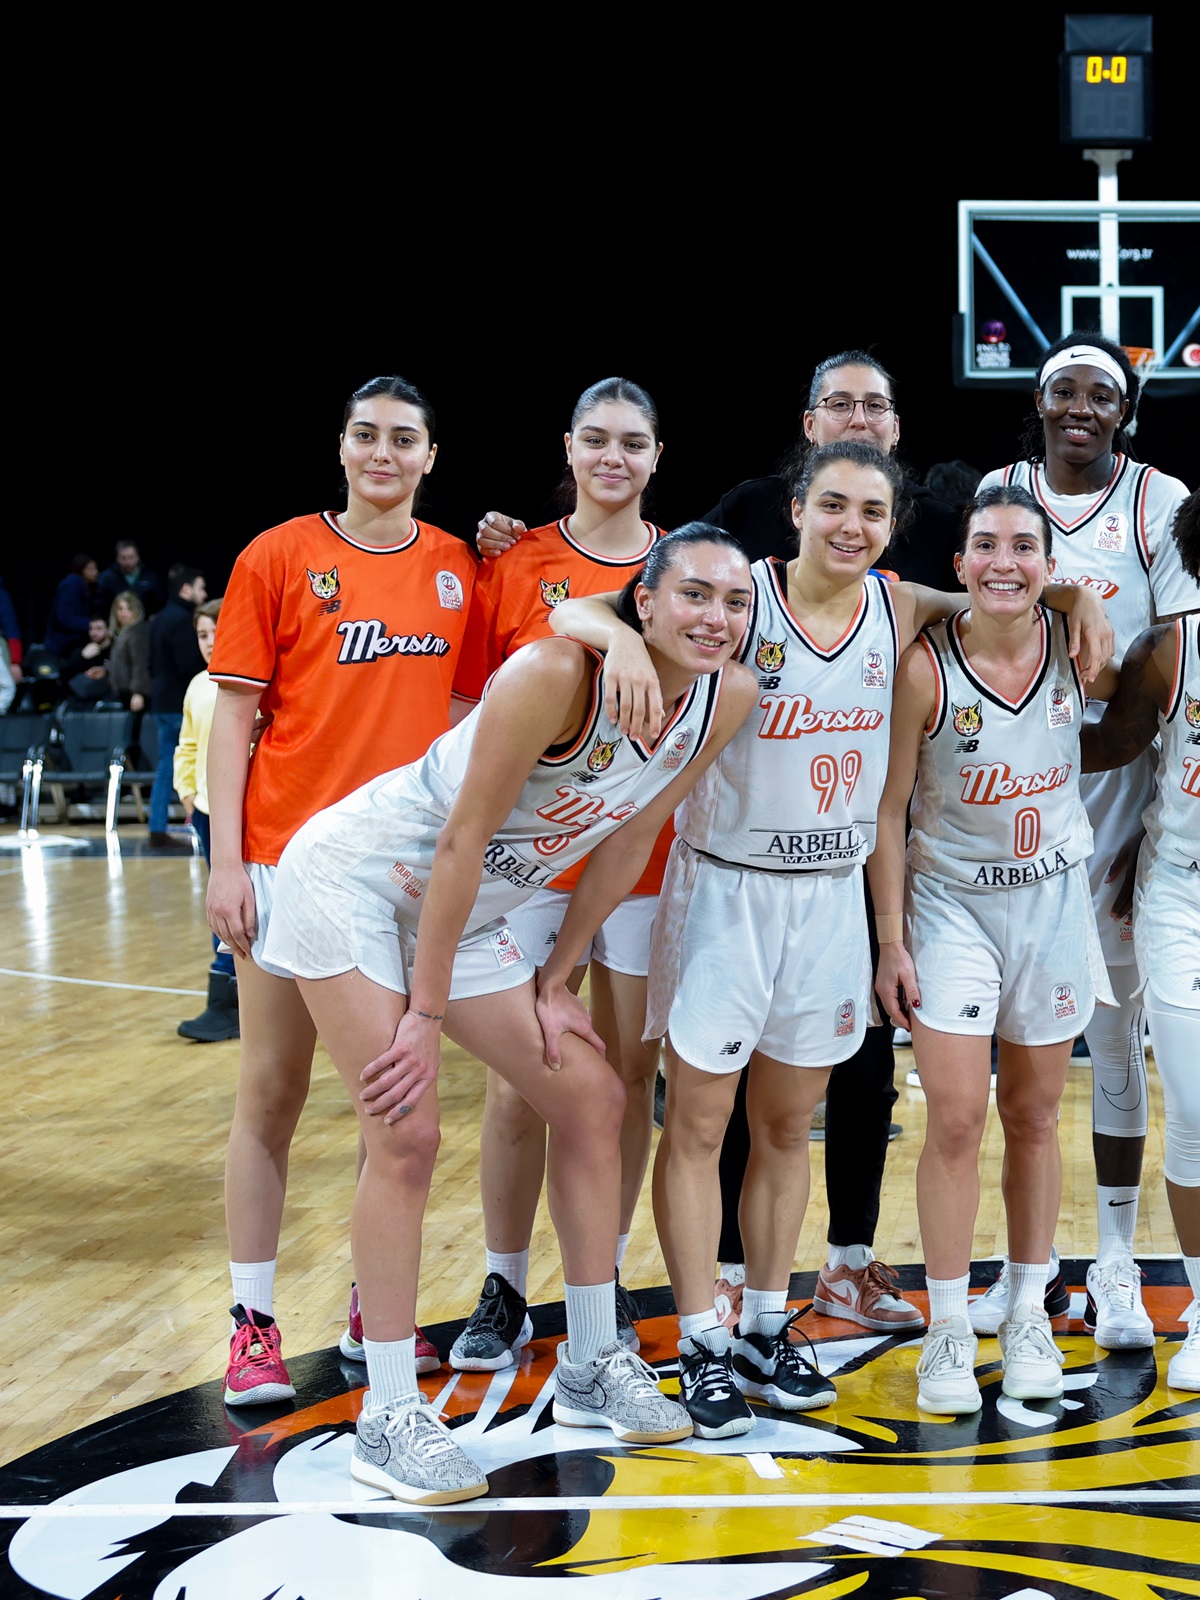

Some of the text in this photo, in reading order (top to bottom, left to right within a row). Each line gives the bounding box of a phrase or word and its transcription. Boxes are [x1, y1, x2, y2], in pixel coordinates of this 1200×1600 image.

[1066, 248, 1154, 261] www..org.tr
[336, 619, 451, 665] Mersin
[757, 694, 884, 740] Mersin
[810, 749, 863, 815] 99
[959, 762, 1073, 806] Mersin
[1014, 806, 1041, 859] 0
[392, 861, 426, 890] YOUR CITY
[784, 848, 860, 865] MAKARNA
[973, 850, 1069, 887] ARBELLA
[385, 868, 422, 900] YOUR TEAM
